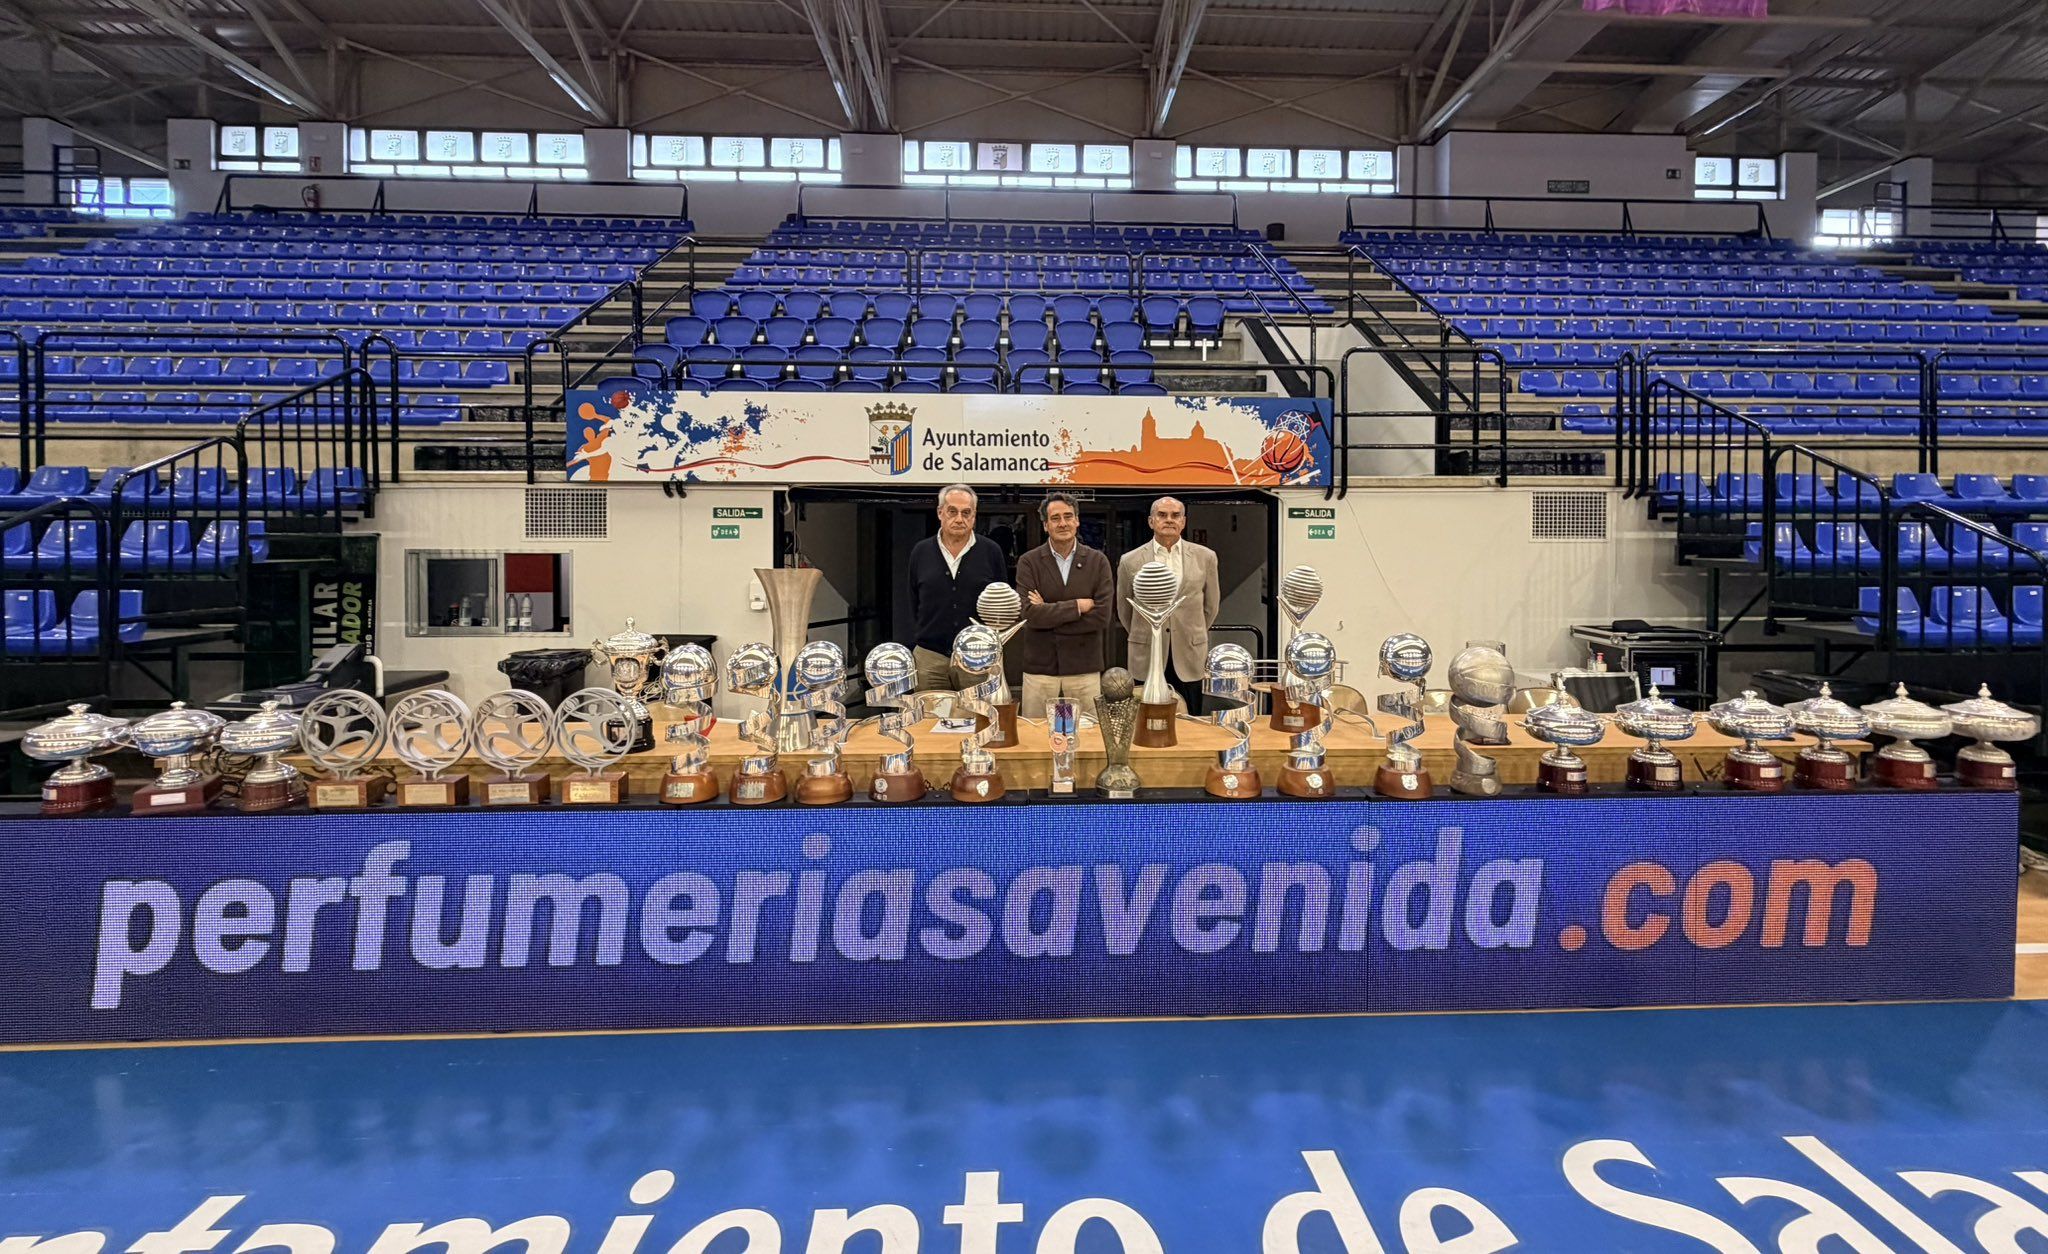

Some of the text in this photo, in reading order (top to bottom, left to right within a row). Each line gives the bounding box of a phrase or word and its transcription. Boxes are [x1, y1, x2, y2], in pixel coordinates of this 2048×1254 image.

[922, 428, 1050, 450] Ayuntamiento
[922, 453, 1049, 472] de Salamanca
[716, 508, 746, 518] SALIDA
[1304, 509, 1332, 518] SALIDA
[720, 528, 733, 536] DEA
[1562, 1135, 2048, 1254] Sala
